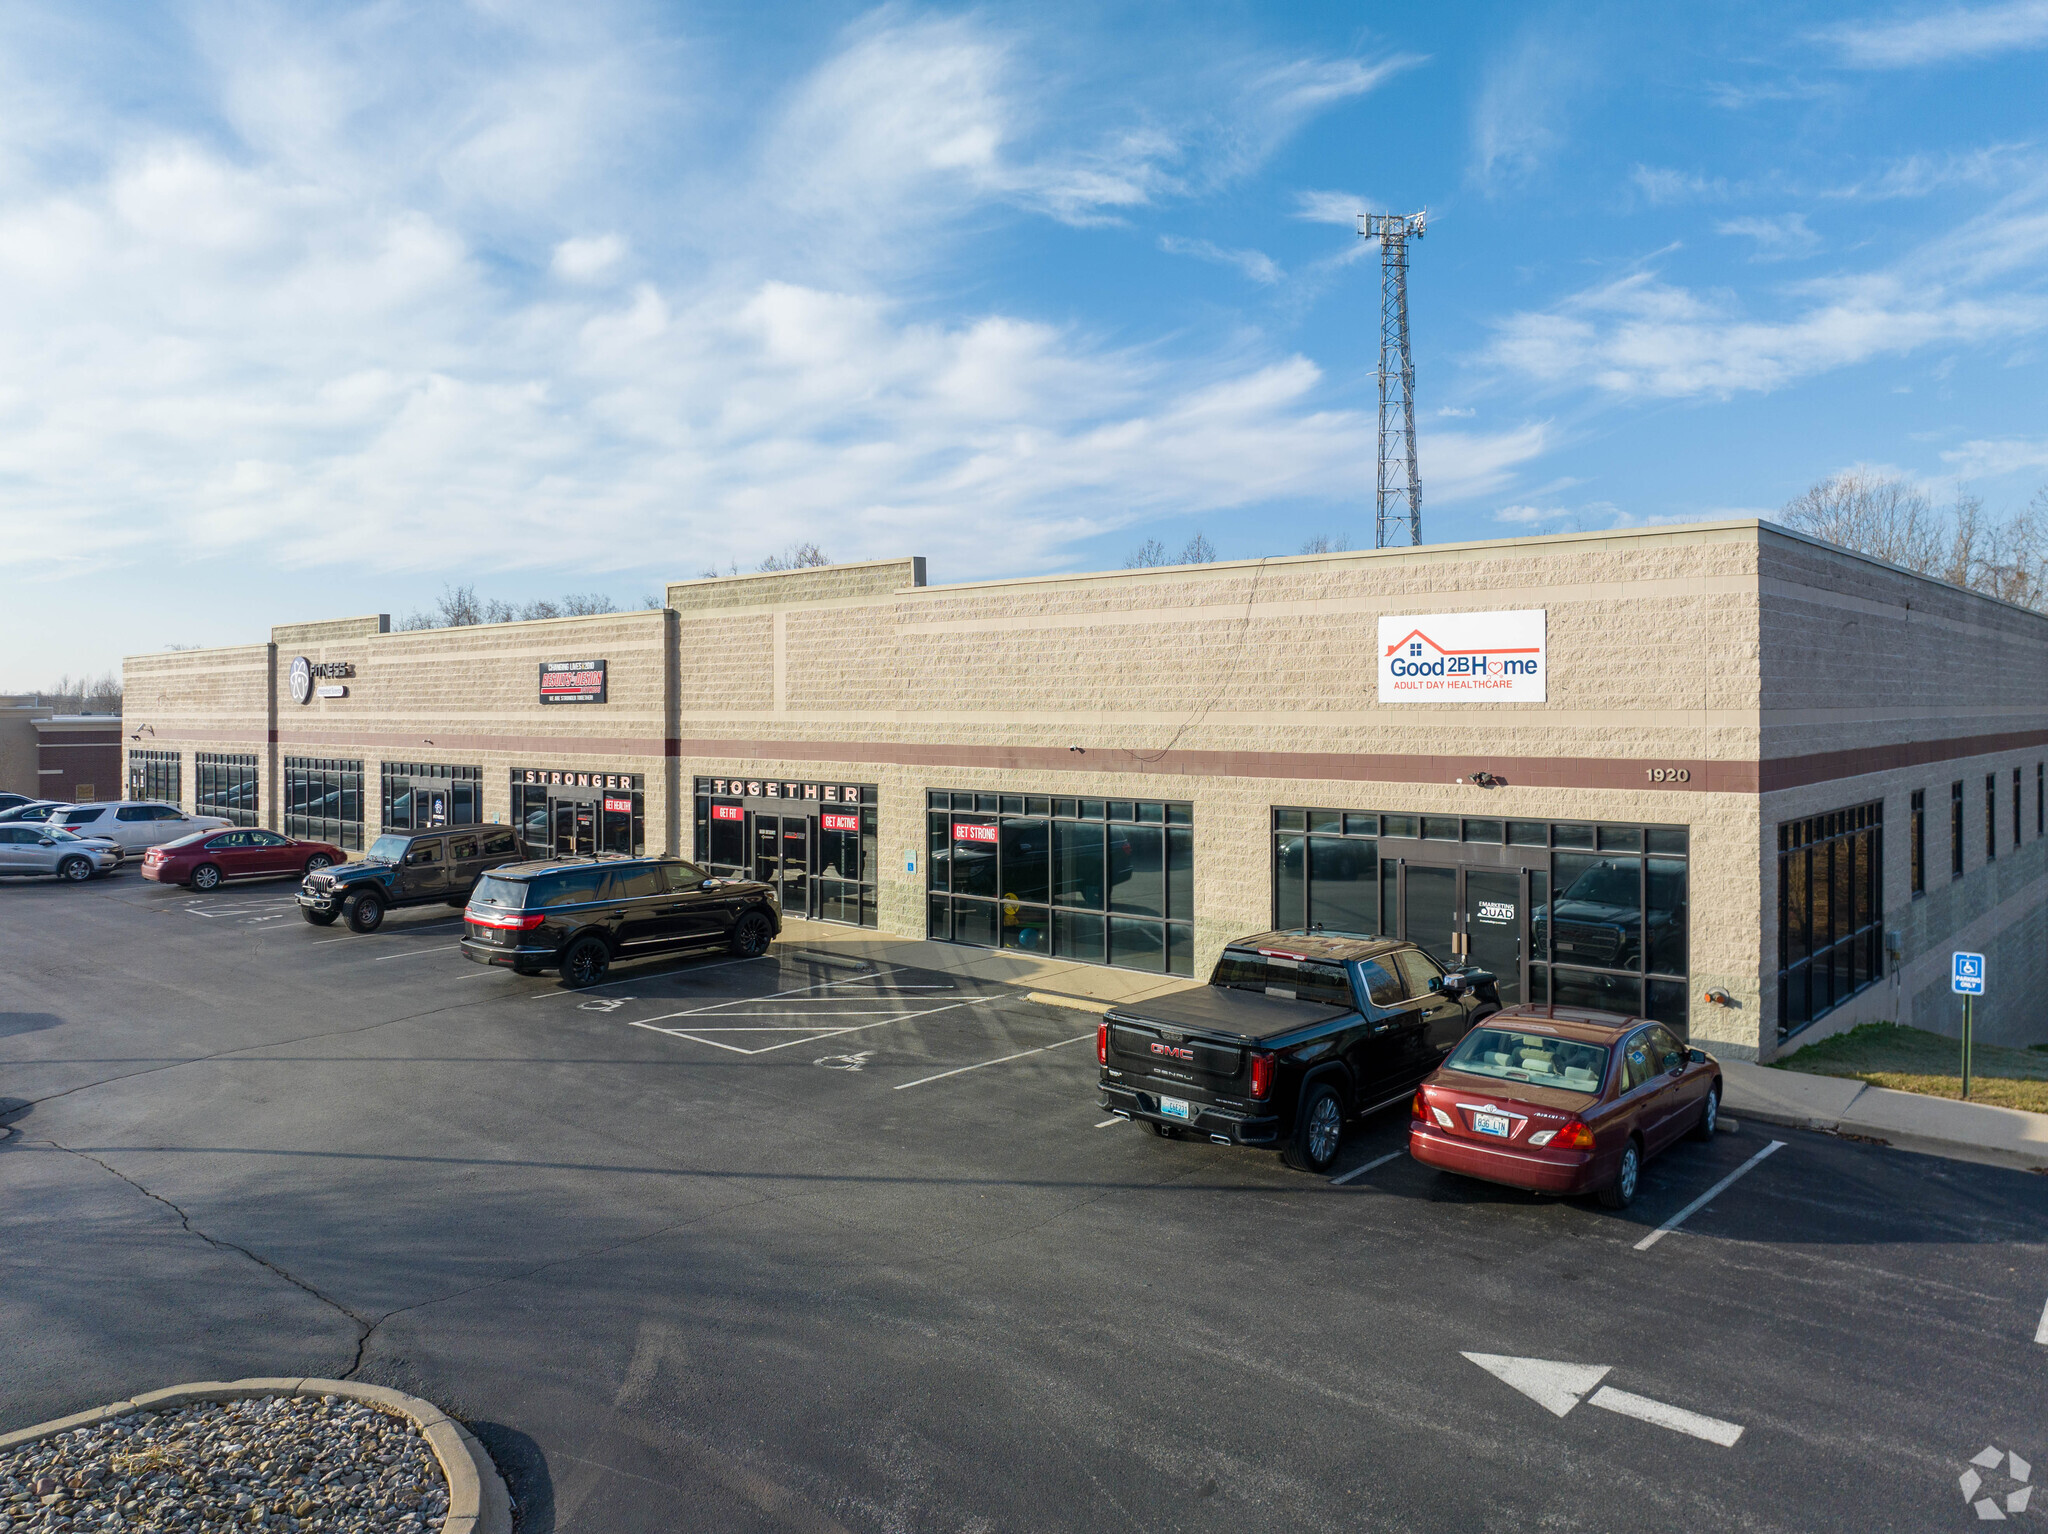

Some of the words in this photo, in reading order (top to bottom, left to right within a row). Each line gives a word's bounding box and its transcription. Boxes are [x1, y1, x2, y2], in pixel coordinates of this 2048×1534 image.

[310, 662, 347, 678] FITNESS
[548, 663, 569, 671] CHANGING
[1391, 657, 1445, 677] Good
[1447, 657, 1470, 673] 2B
[542, 673, 572, 687] RESULTS
[575, 671, 603, 686] DESIGN
[1394, 681, 1424, 690] ADULT
[1426, 681, 1445, 689] DAY
[1447, 680, 1513, 689] HEALTHCARE
[526, 771, 630, 789] STRONGER
[1646, 768, 1690, 783] 1920
[715, 780, 858, 802] TOGETHER
[605, 800, 613, 810] GET
[614, 800, 631, 811] HEALTHY
[719, 808, 729, 817] GET
[729, 808, 737, 818] FIT
[825, 816, 836, 827] GET
[836, 817, 856, 829] ACTIVE
[956, 826, 969, 838] GET
[970, 827, 996, 840] STRONG
[1479, 901, 1515, 910] EMARKETING
[1480, 907, 1513, 919] QUAD
[1955, 975, 1981, 984] PARKING
[1960, 981, 1977, 989] ONLY
[1151, 1042, 1194, 1060] GMC
[1153, 1068, 1193, 1080] DENALI
[1477, 1118, 1489, 1128] 836
